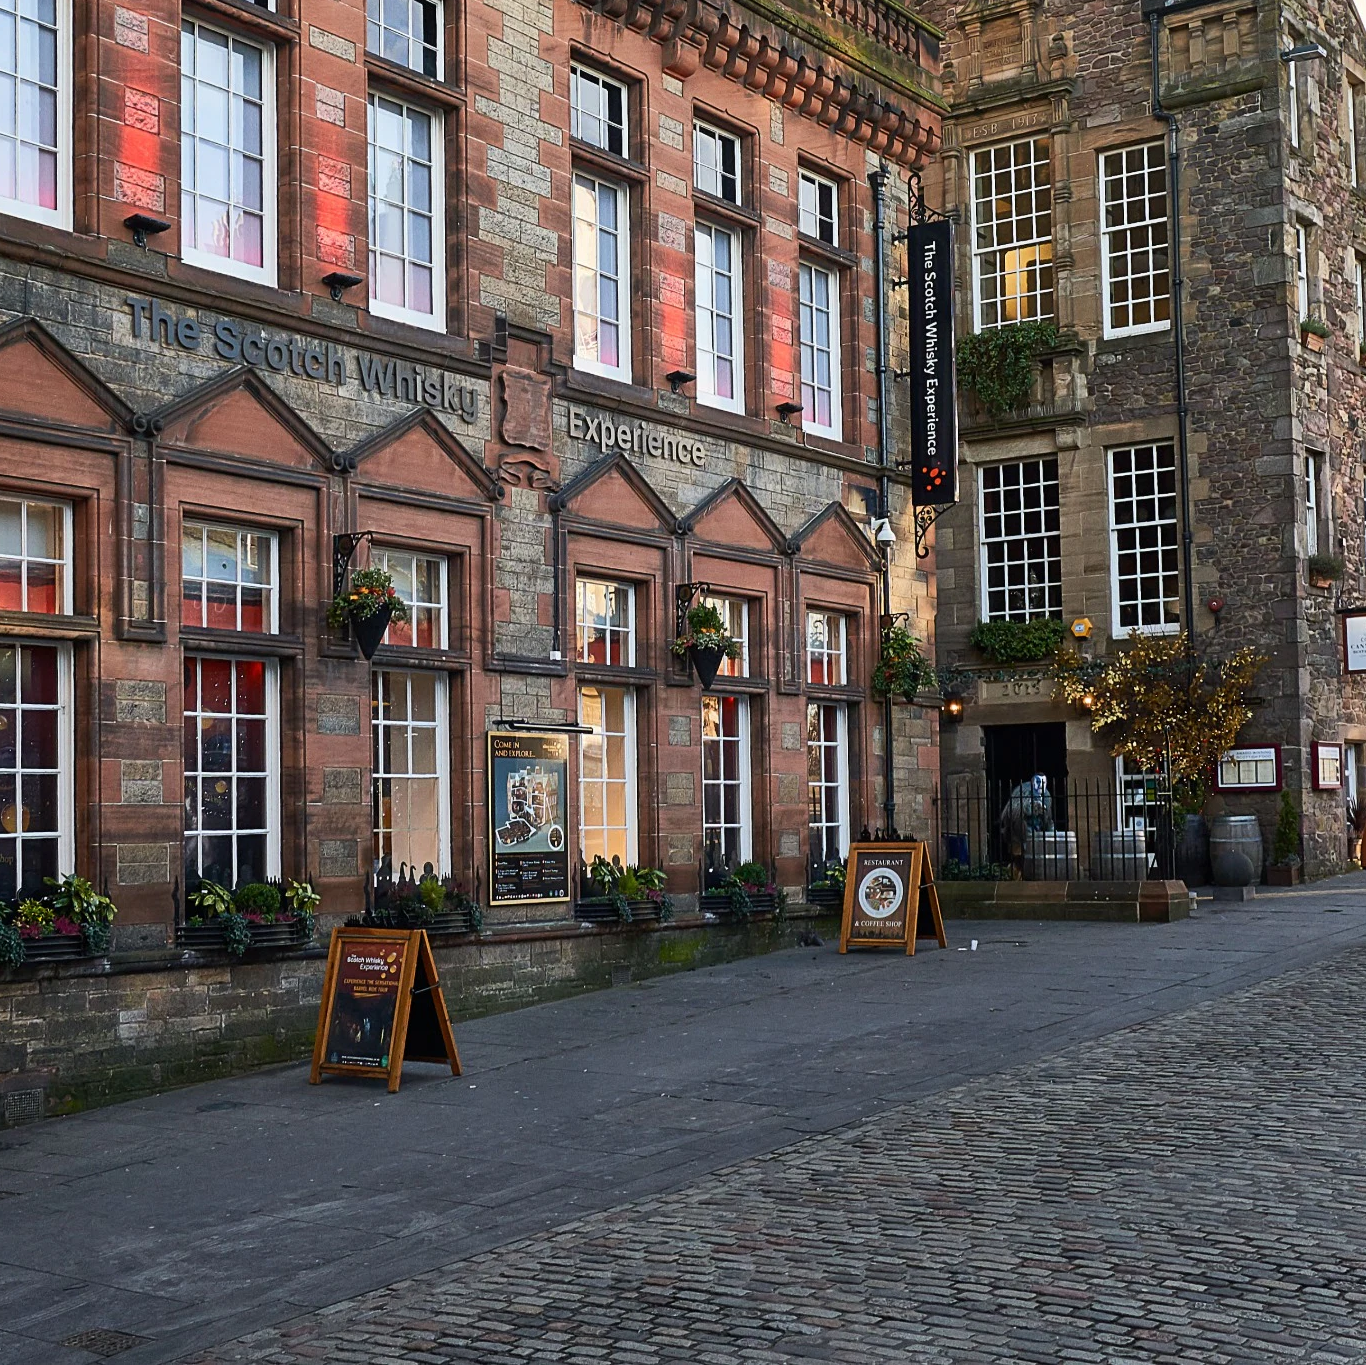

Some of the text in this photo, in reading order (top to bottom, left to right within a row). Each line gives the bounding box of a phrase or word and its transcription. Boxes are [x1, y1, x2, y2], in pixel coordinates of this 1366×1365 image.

[126, 296, 479, 424] The Scotch Whisky
[923, 240, 939, 457] The Scotch Whisky Experience
[568, 406, 706, 467] Experience
[359, 963, 389, 971] Experience
[365, 957, 385, 965] Whisky
